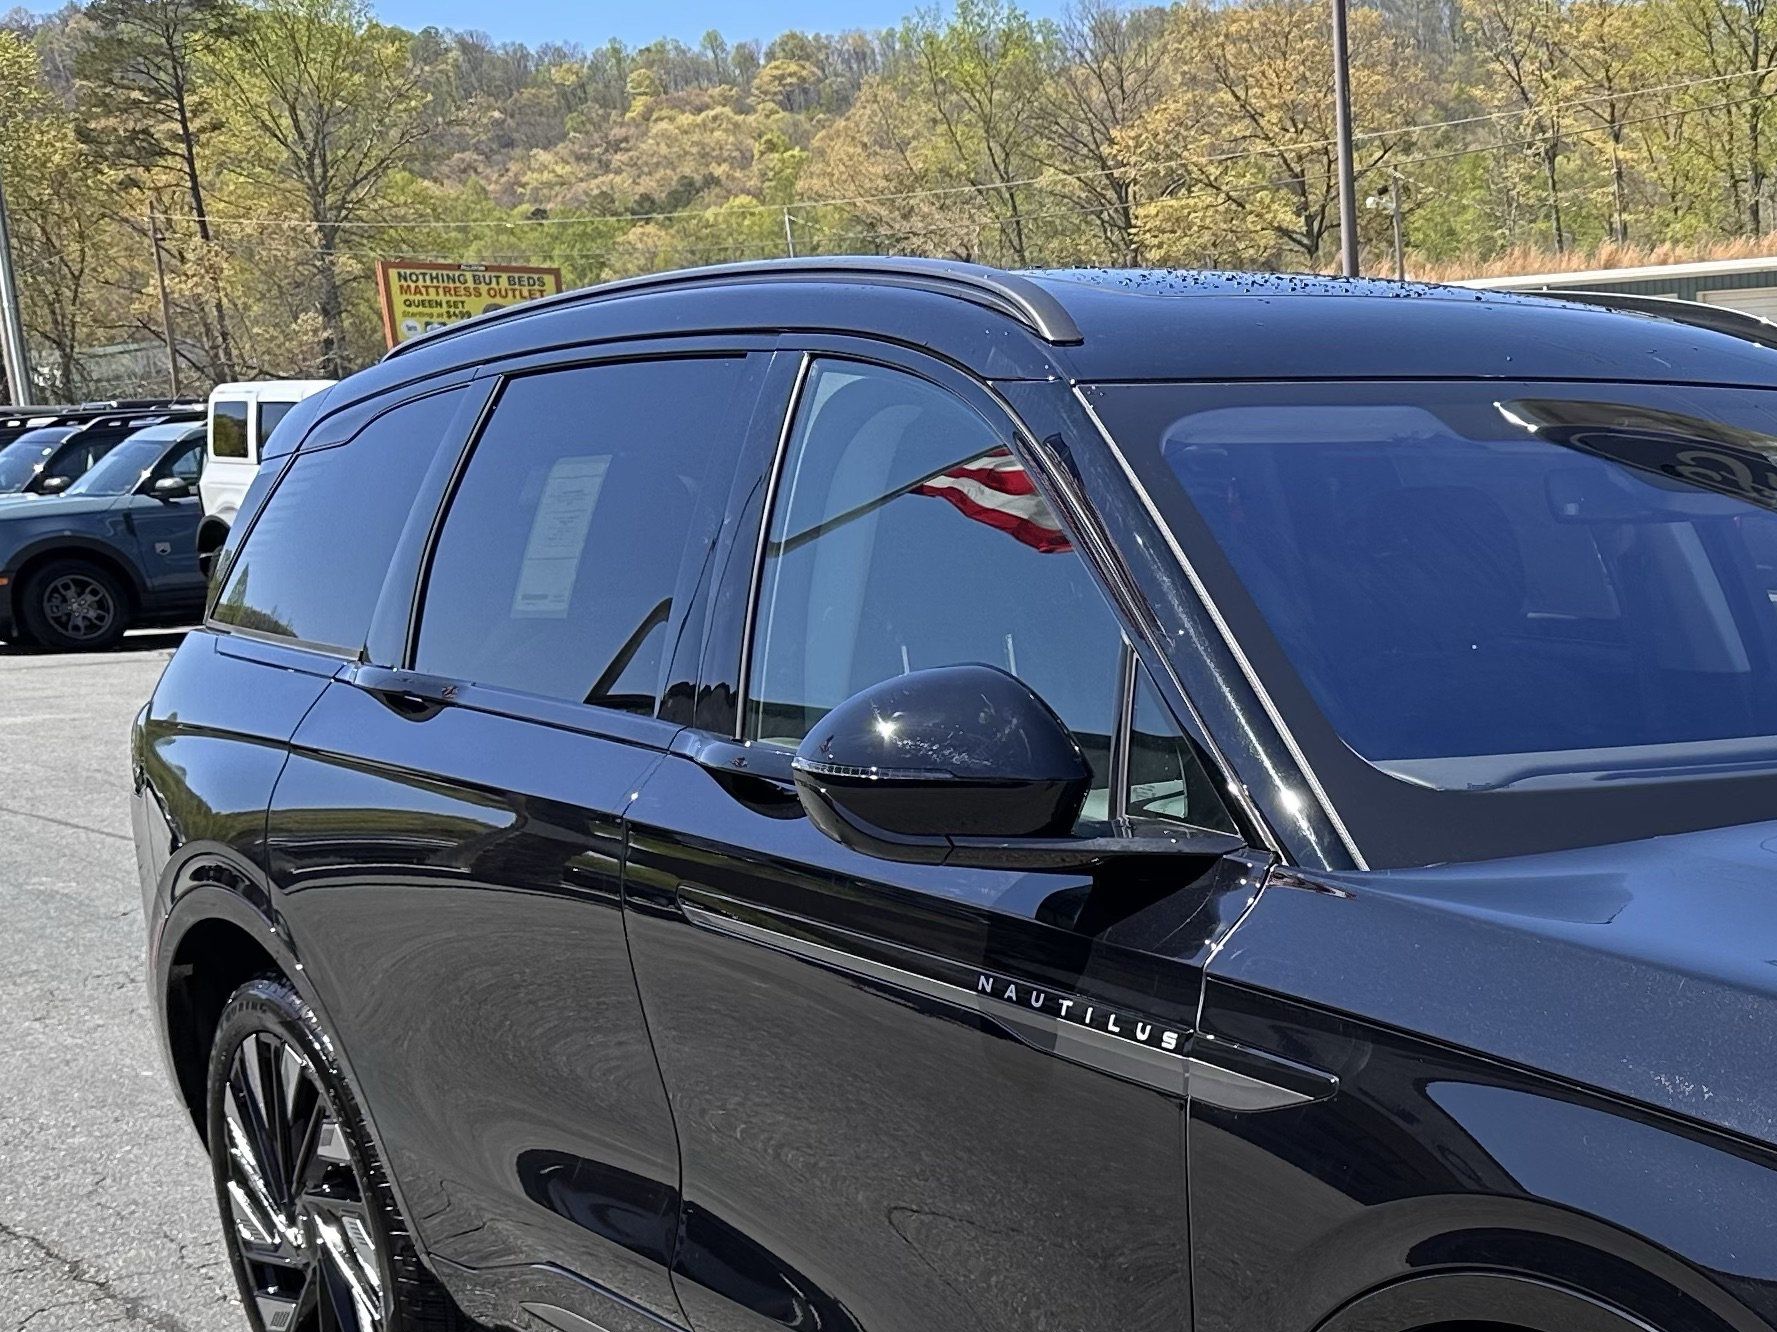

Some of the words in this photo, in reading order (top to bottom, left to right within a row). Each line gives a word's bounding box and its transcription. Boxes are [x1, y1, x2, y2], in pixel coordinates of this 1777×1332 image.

[397, 271, 468, 285] NOTHING
[472, 274, 502, 286] BUT
[508, 275, 546, 287] BEDS
[399, 284, 482, 298] MATTRESS
[487, 287, 546, 299] OUTLET
[403, 298, 443, 308] QUEEN
[446, 300, 466, 309] SET
[977, 974, 1179, 1050] NAUTILUS
